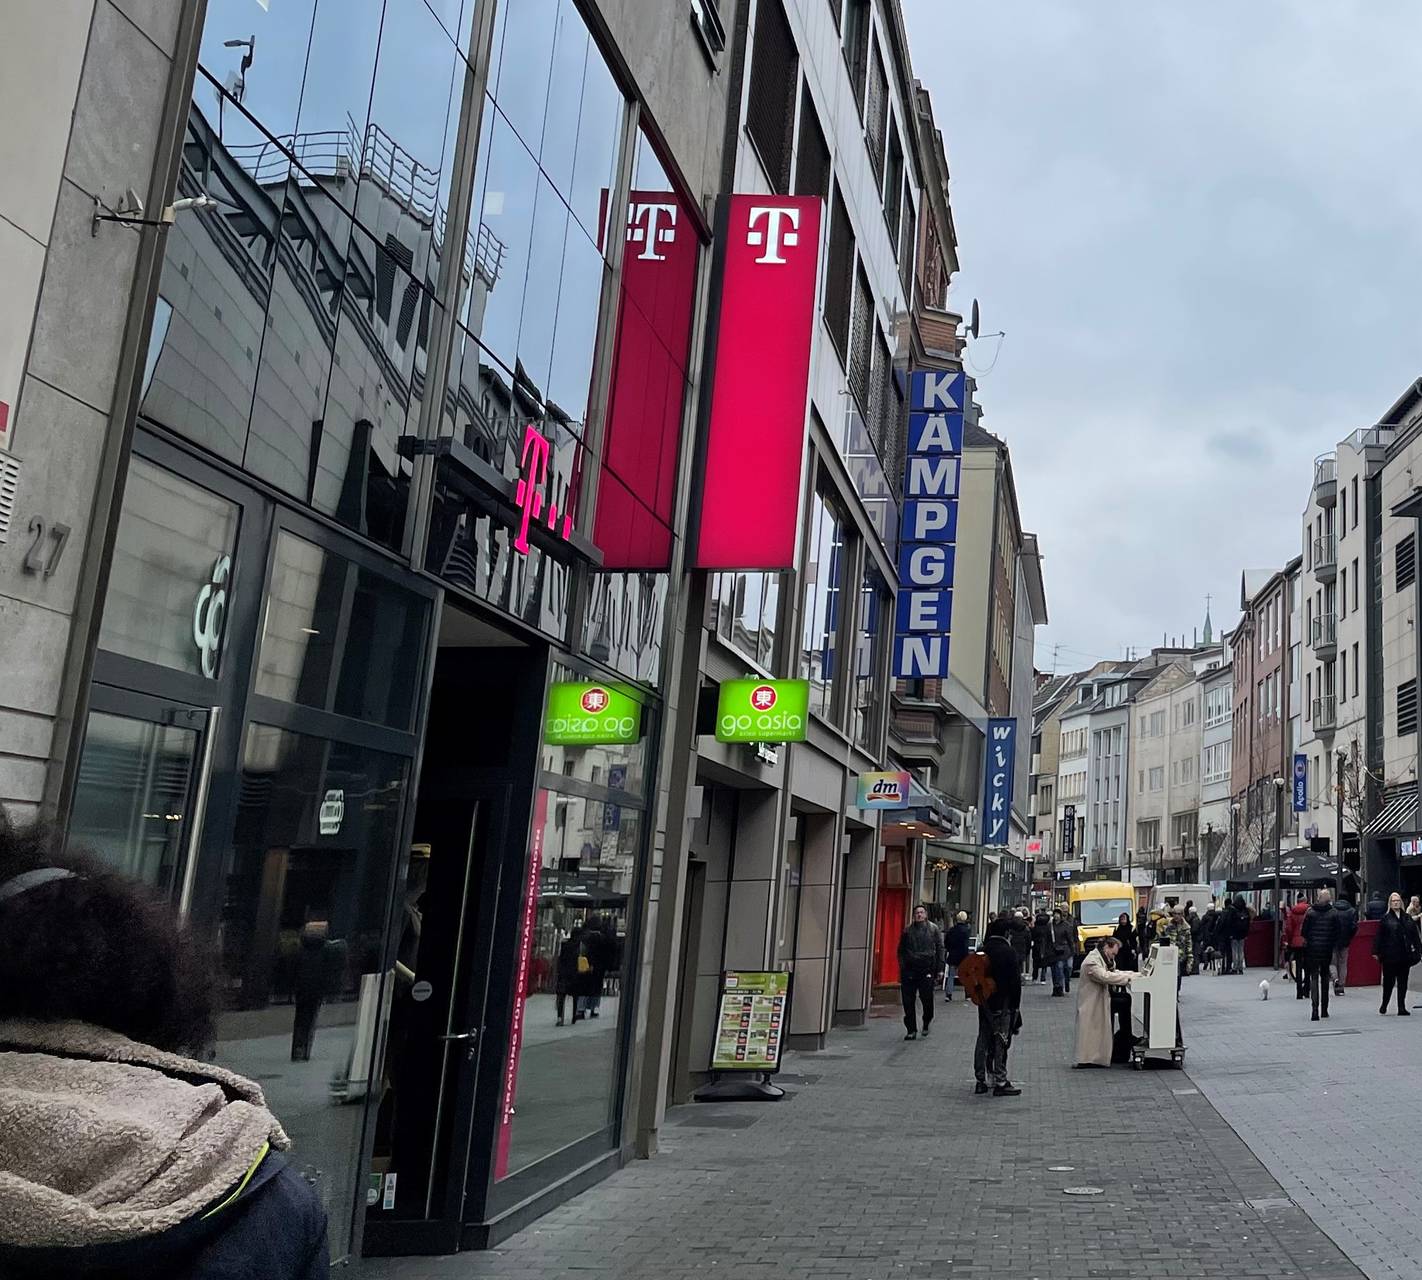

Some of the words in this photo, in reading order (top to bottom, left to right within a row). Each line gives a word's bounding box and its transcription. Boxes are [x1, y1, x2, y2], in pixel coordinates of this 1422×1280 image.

[747, 207, 799, 264] T
[22, 514, 72, 578] 27
[900, 373, 959, 676] KÄMPGEN
[721, 714, 752, 737] go
[756, 710, 801, 730] asia
[755, 689, 772, 706] 東
[872, 779, 898, 794] dm
[988, 726, 1011, 838] wicky
[1296, 781, 1304, 807] Apollo
[503, 1033, 518, 1124] BERATUNG
[513, 997, 521, 1029] FÜR
[518, 829, 541, 993] GESCHÄFTSKUNDEN
